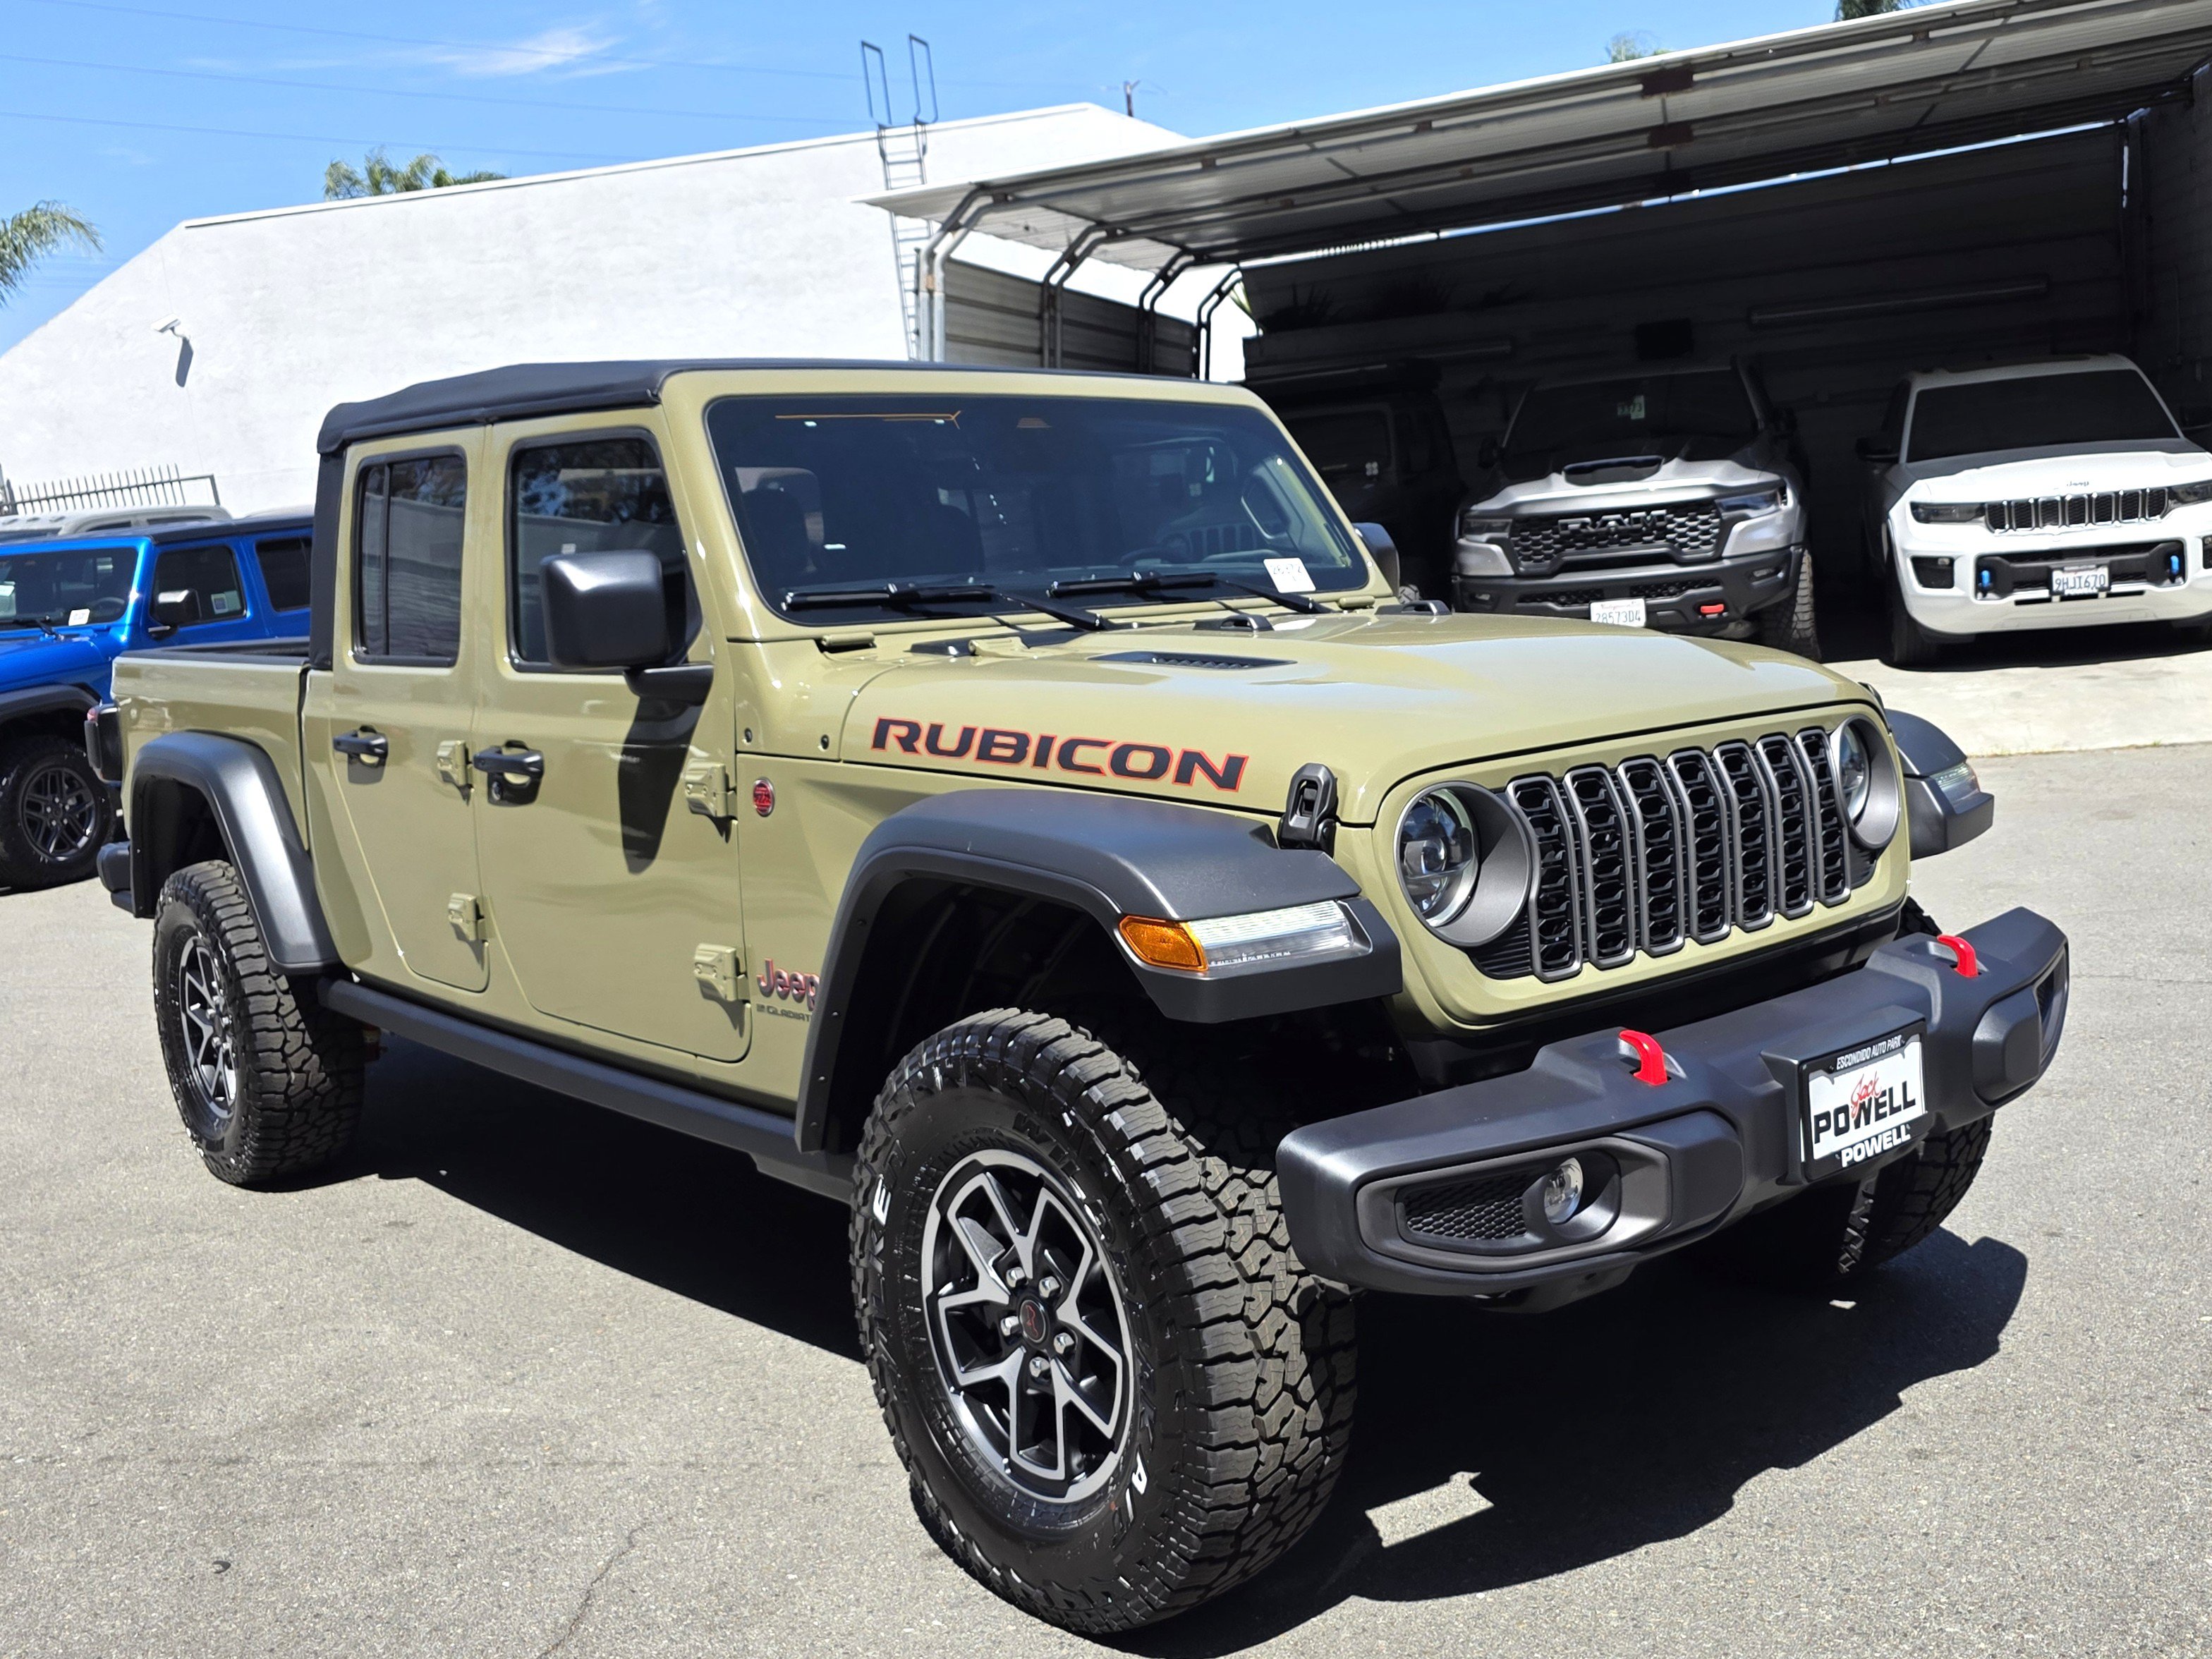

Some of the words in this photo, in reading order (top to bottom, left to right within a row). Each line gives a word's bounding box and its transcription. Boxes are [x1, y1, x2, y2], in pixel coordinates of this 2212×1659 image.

[1557, 509, 1668, 534] RAM
[871, 717, 1249, 792] RUBICON
[756, 958, 820, 1012] Jeep
[1836, 1047, 1871, 1070] ESCONDIDO
[1871, 1041, 1887, 1057] AUTO
[1887, 1034, 1902, 1052] PARK
[1813, 1081, 1916, 1144] POWELL
[1850, 1071, 1883, 1119] Jack
[1841, 1124, 1911, 1167] POWELL
